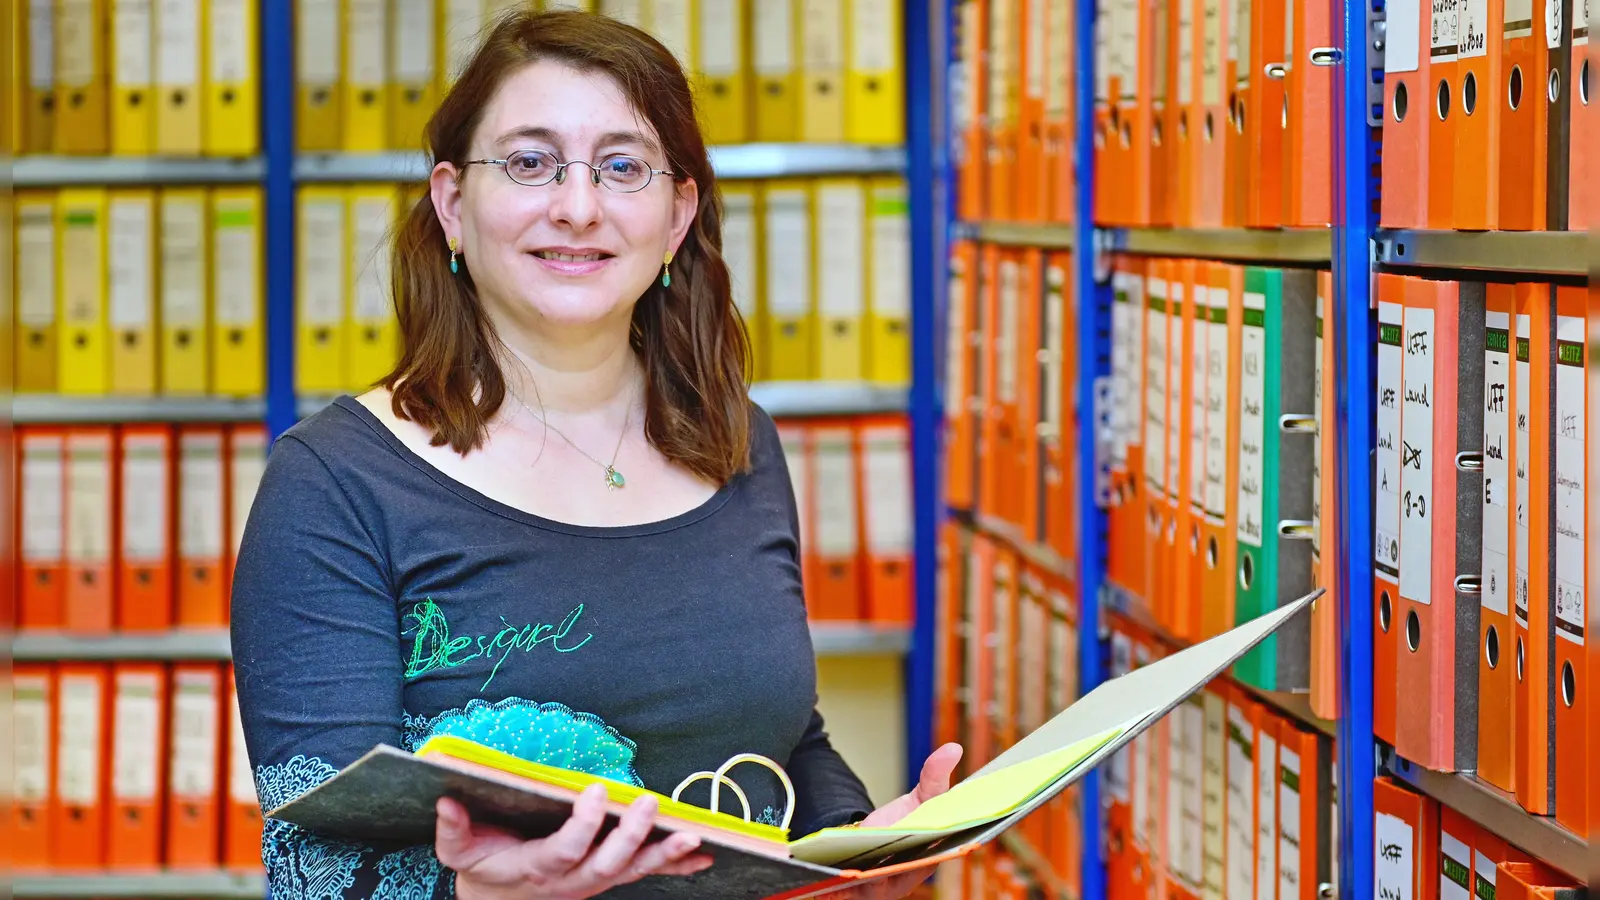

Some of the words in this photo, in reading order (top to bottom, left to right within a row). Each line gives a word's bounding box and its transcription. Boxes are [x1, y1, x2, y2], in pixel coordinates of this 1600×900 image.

[1384, 325, 1399, 342] LEITZ
[1407, 330, 1427, 355] UFF
[1487, 332, 1507, 349] centra
[1563, 345, 1581, 362] LEITZ
[1405, 380, 1429, 407] Land
[1487, 382, 1504, 413] UFF
[1486, 433, 1503, 460] Land
[1381, 468, 1388, 490] A
[1485, 478, 1492, 504] E
[401, 596, 592, 692] Desigual
[1448, 860, 1467, 885] LEITZ
